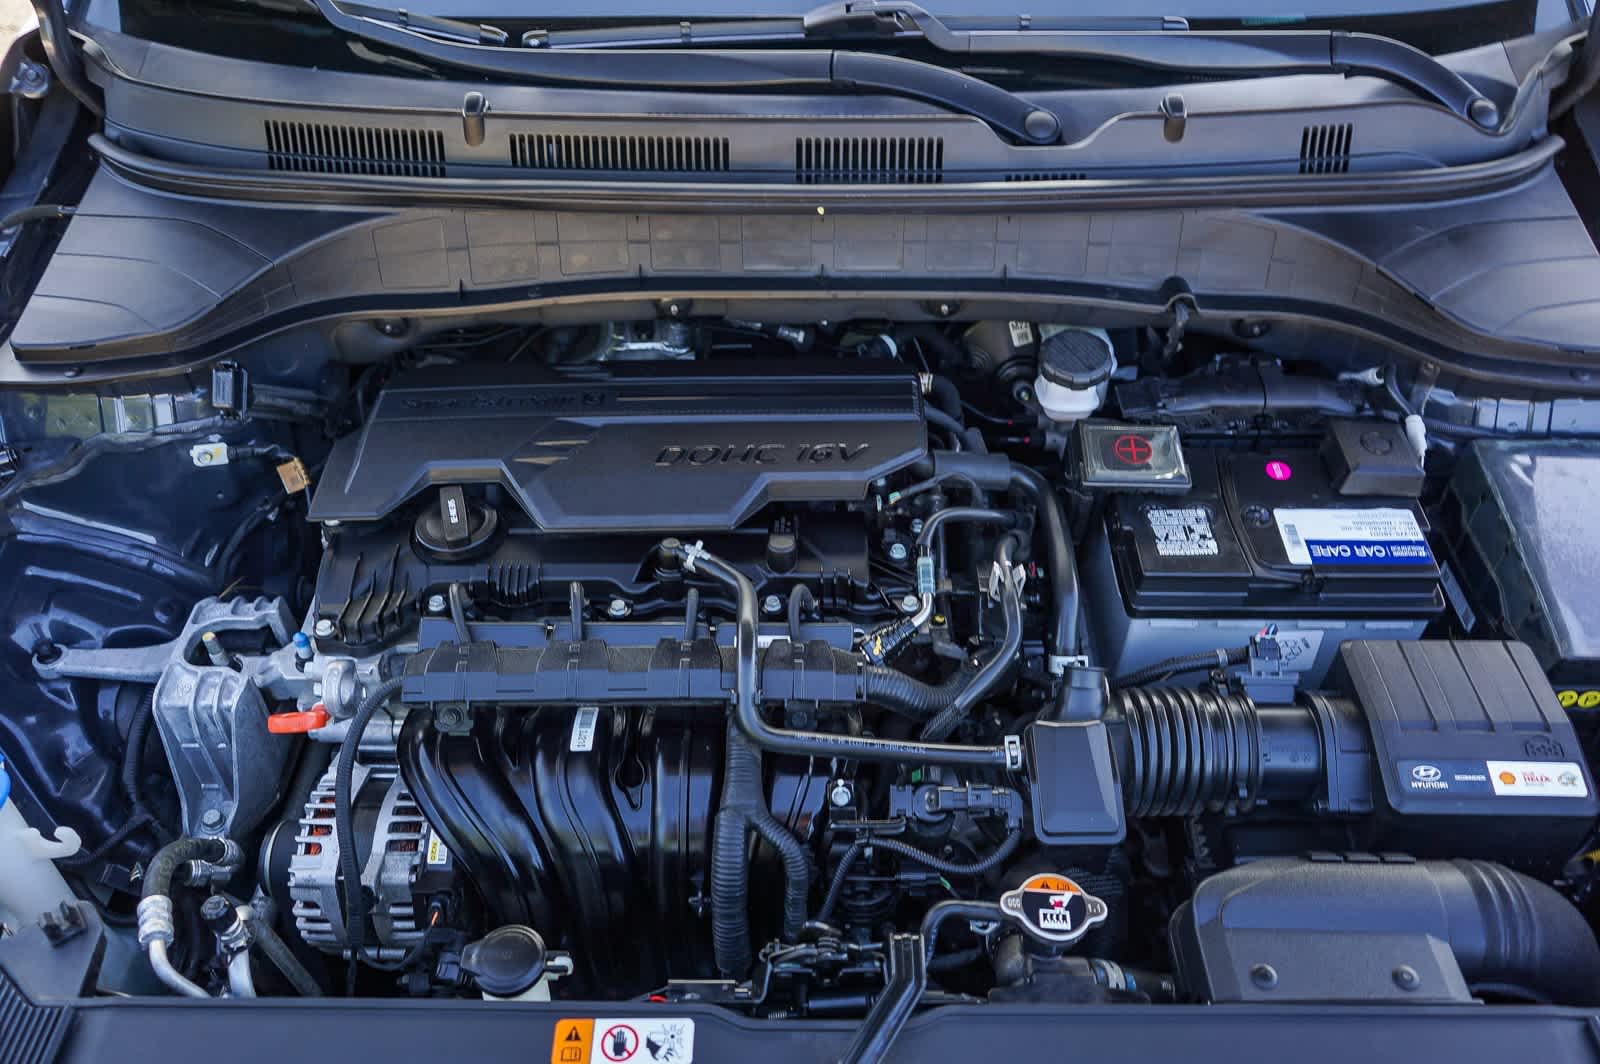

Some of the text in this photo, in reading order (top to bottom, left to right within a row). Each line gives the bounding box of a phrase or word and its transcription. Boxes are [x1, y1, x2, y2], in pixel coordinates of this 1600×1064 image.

[655, 442, 870, 466] DOHC 16V
[1310, 544, 1351, 558] CARE
